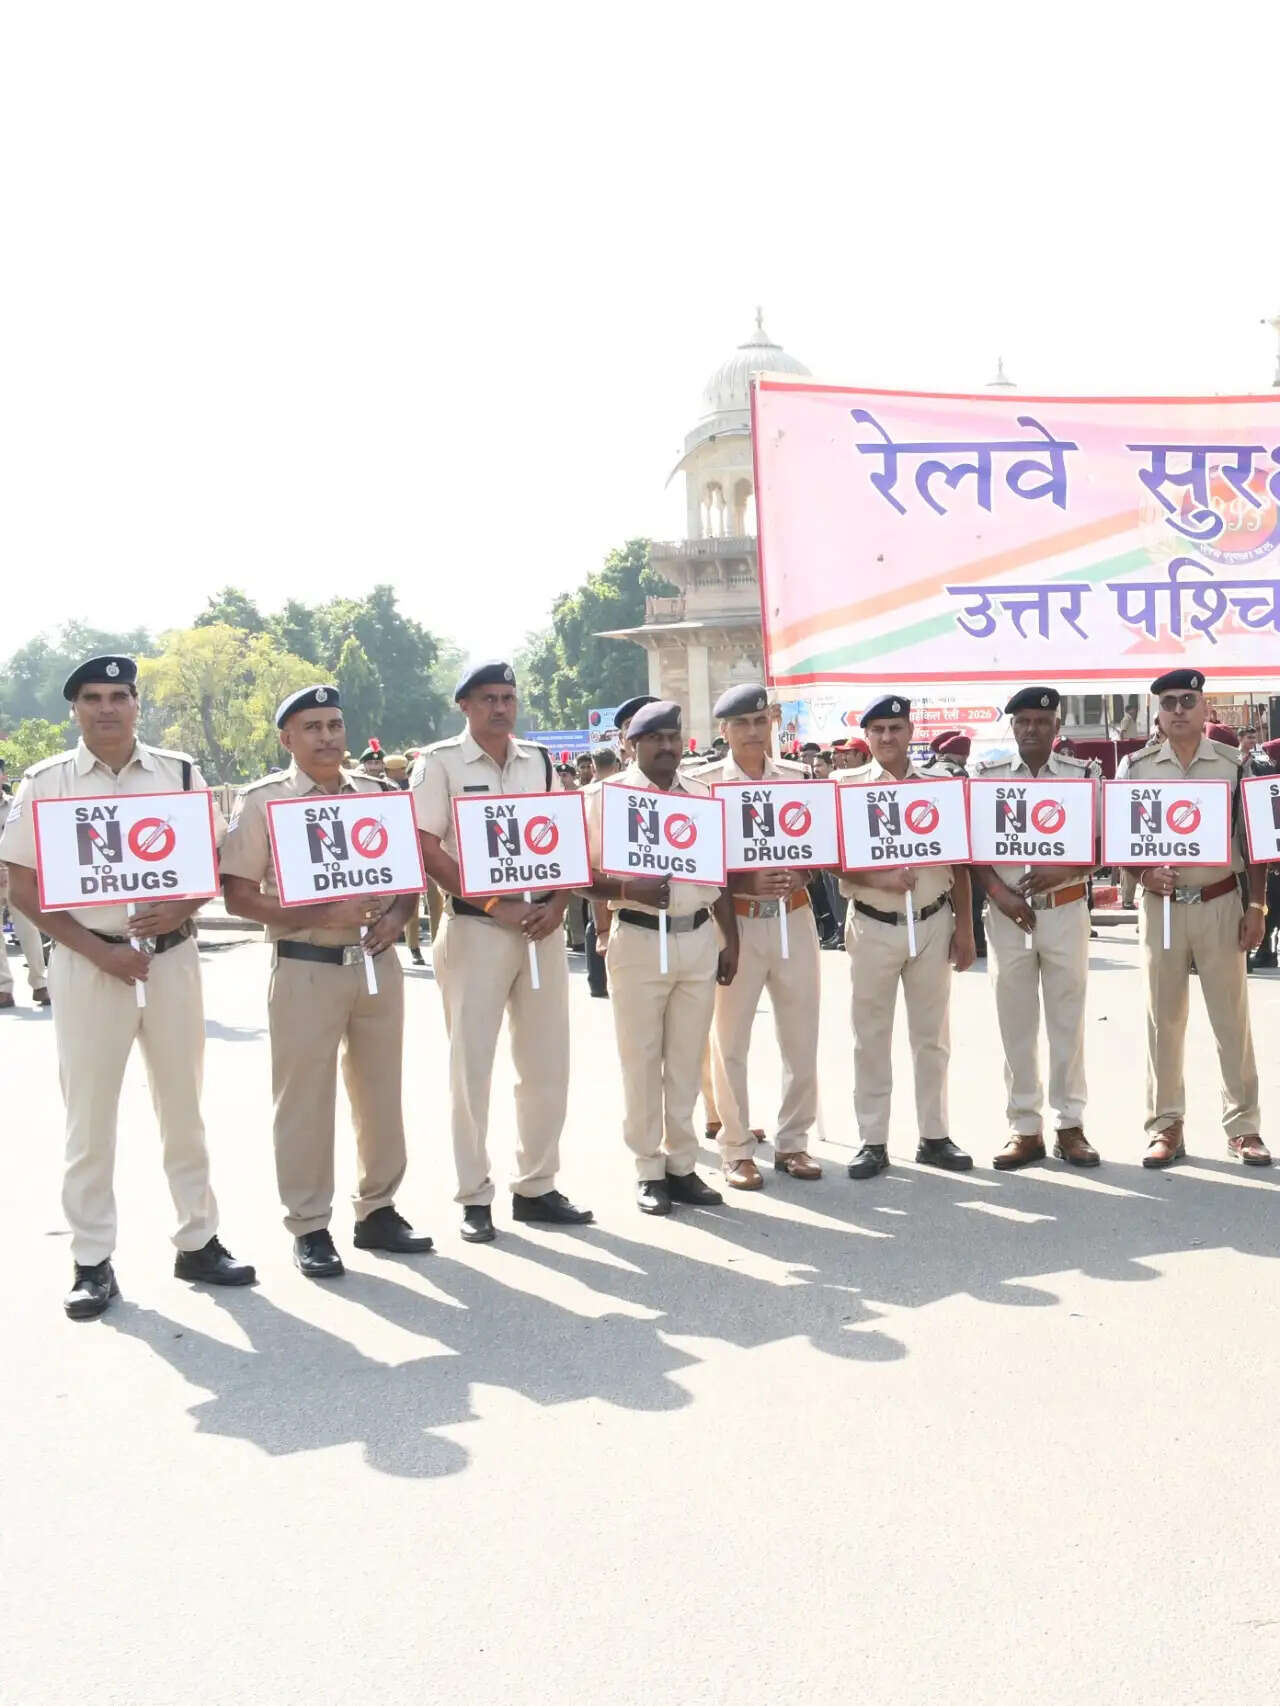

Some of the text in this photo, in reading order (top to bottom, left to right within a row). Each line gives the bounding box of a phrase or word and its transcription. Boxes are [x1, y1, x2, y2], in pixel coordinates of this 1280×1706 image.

[851, 410, 1078, 514] रेलवे
[945, 584, 1090, 640] उत्तर
[742, 790, 771, 803] SAY
[867, 791, 896, 803] SAY
[996, 788, 1026, 799] SAY
[1131, 789, 1161, 800] SAY
[628, 796, 657, 810] SAY
[75, 806, 118, 822] SAY
[305, 807, 340, 821] SAY
[485, 805, 515, 819] SAY
[752, 838, 767, 846] TO
[880, 837, 894, 845] TO
[637, 844, 651, 853] TO
[744, 845, 812, 862] DRUGS
[871, 841, 941, 860] DRUGS
[996, 842, 1064, 856] DRUGS
[1131, 842, 1200, 856] DRUGS
[323, 862, 340, 872] TO
[498, 857, 513, 866] TO
[629, 852, 697, 873] DRUGS
[92, 865, 112, 875] TO
[490, 863, 561, 883] DRUGS
[81, 870, 178, 894] DRUGS
[314, 867, 392, 891] DRUGS
